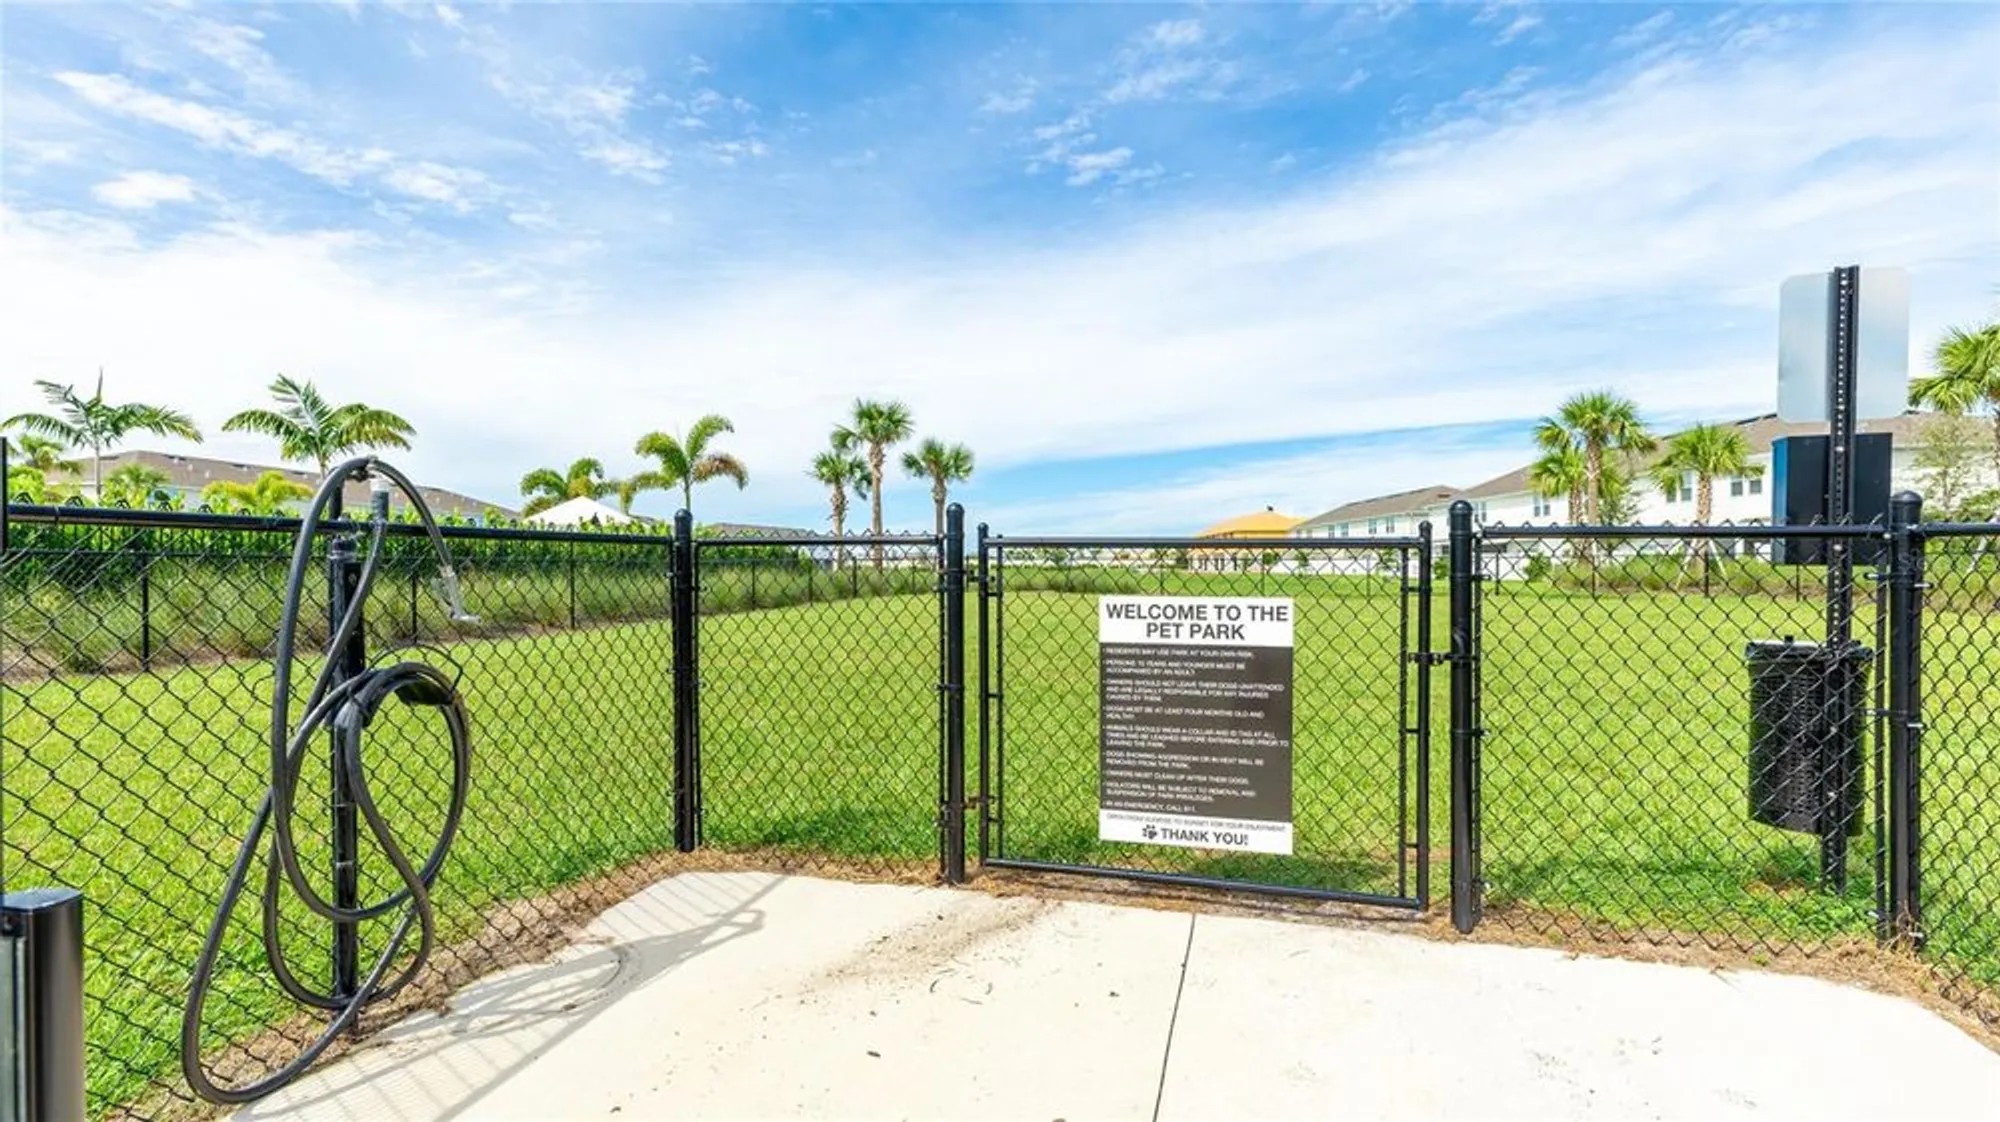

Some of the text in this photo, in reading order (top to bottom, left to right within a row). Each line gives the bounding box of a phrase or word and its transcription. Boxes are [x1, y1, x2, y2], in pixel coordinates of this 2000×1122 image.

[1106, 603, 1288, 621] WELCOME TO THE
[1146, 622, 1244, 640] PET PARK
[1157, 648, 1169, 656] USE
[1199, 649, 1218, 657] YOUR
[1220, 650, 1235, 658] OWN
[1183, 661, 1215, 669] YOUNGER
[1106, 666, 1151, 675] ACCOMPANIED
[1106, 678, 1132, 686] OWNERS
[1134, 679, 1161, 687] SHOULD
[1176, 680, 1196, 688] LEAVE
[1198, 681, 1216, 689] THEIR
[1238, 682, 1285, 691] UNATTENDED
[1106, 685, 1118, 693] AND
[1134, 686, 1162, 694] LEGALLY
[1163, 687, 1206, 696] RESPONSIBLE
[1208, 689, 1222, 697] FOR
[1238, 690, 1268, 699] INJURIES
[1184, 707, 1203, 715] FOUR
[1204, 708, 1232, 716] MONTHS
[1234, 709, 1248, 717] OLD
[1249, 710, 1264, 718] AND
[1134, 725, 1160, 733] SHOULD
[1162, 726, 1180, 734] WEAR
[1188, 727, 1213, 735] COLLAR
[1106, 739, 1132, 747] LEAVING
[1149, 733, 1179, 741] LEASHED
[1180, 735, 1204, 743] BEFORE
[1207, 736, 1240, 744] ENTERING
[1256, 738, 1278, 746] PRIOR
[1106, 758, 1136, 766] REMOVED
[1138, 759, 1156, 767] FROM
[1134, 771, 1152, 779] MUST
[1153, 772, 1174, 780] CLEAN
[1186, 774, 1206, 782] AFTER
[1207, 775, 1226, 783] THEIR
[1165, 803, 1180, 811] CALL
[1210, 819, 1223, 827] FOR
[1225, 820, 1243, 828] YOUR
[1160, 827, 1248, 845] THANK YOU!
